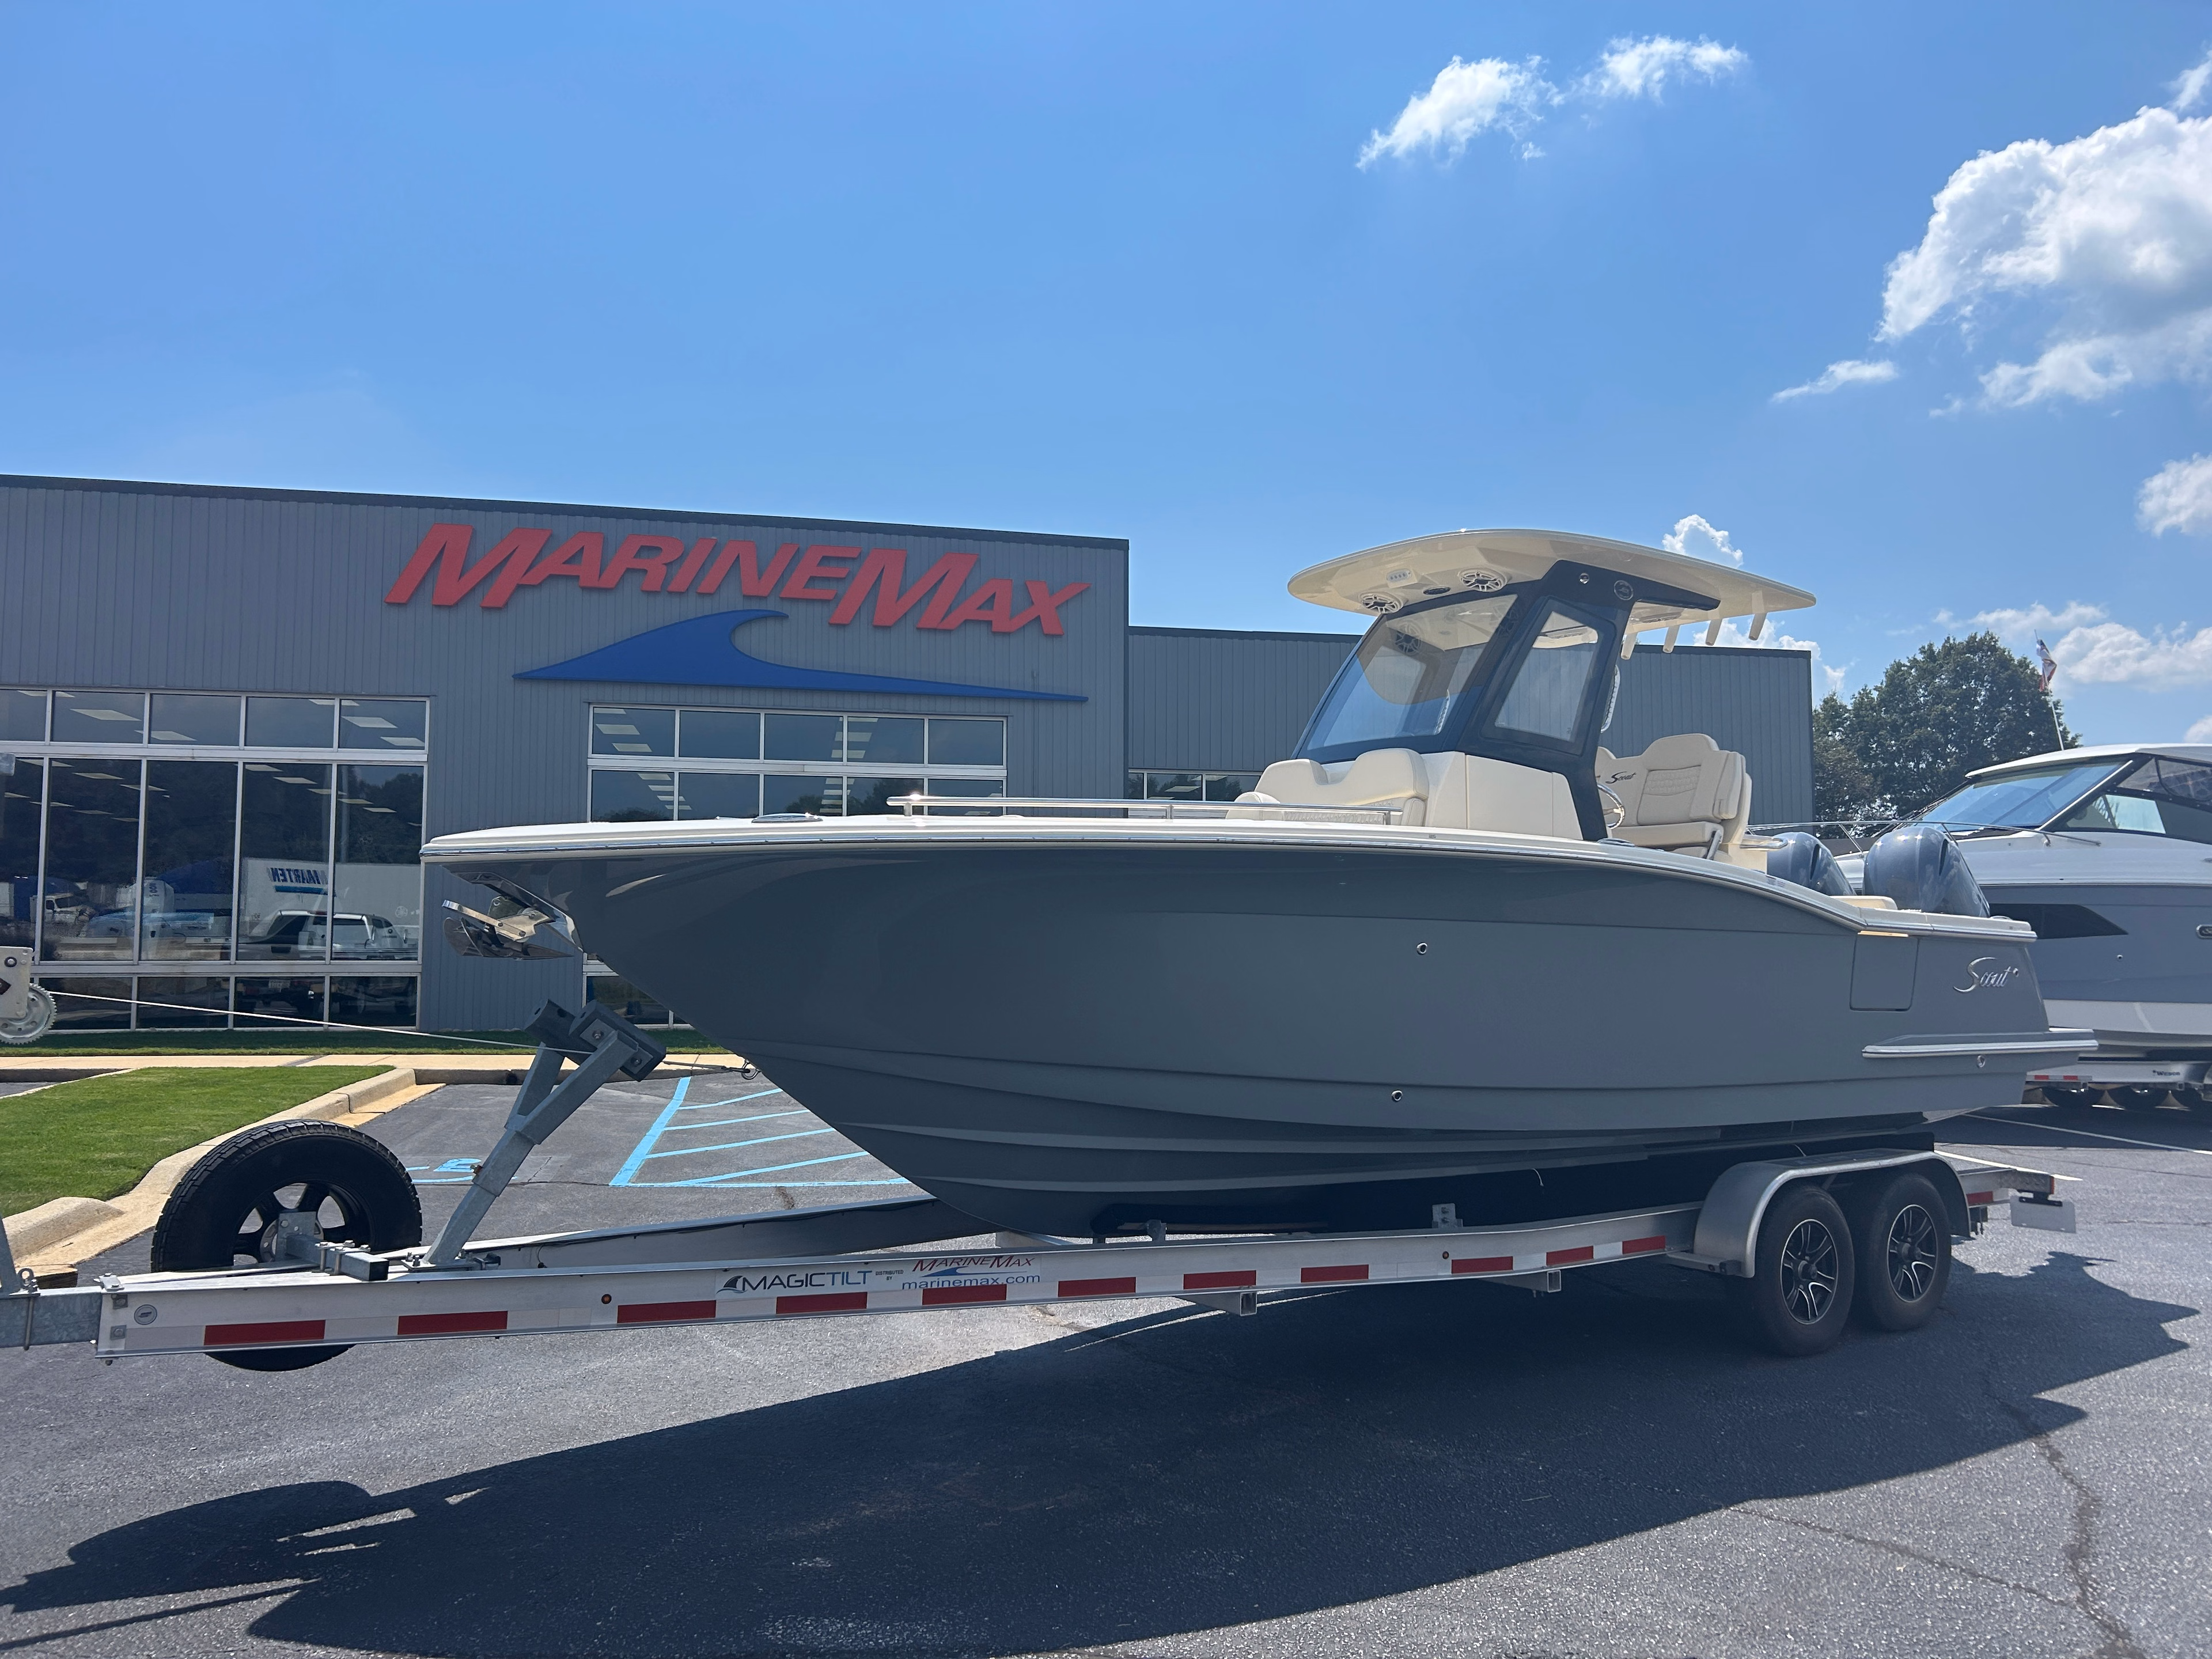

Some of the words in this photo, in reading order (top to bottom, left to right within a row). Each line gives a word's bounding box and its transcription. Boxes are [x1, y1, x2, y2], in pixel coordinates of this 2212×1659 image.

[385, 523, 1092, 636] MARINEMAX
[1605, 771, 1637, 784] Scout
[1953, 957, 2012, 993] Scout
[912, 1255, 1036, 1272] MARINEMAX
[742, 1270, 873, 1291] MAGICTILT
[902, 1274, 1041, 1290] marinemax.com
